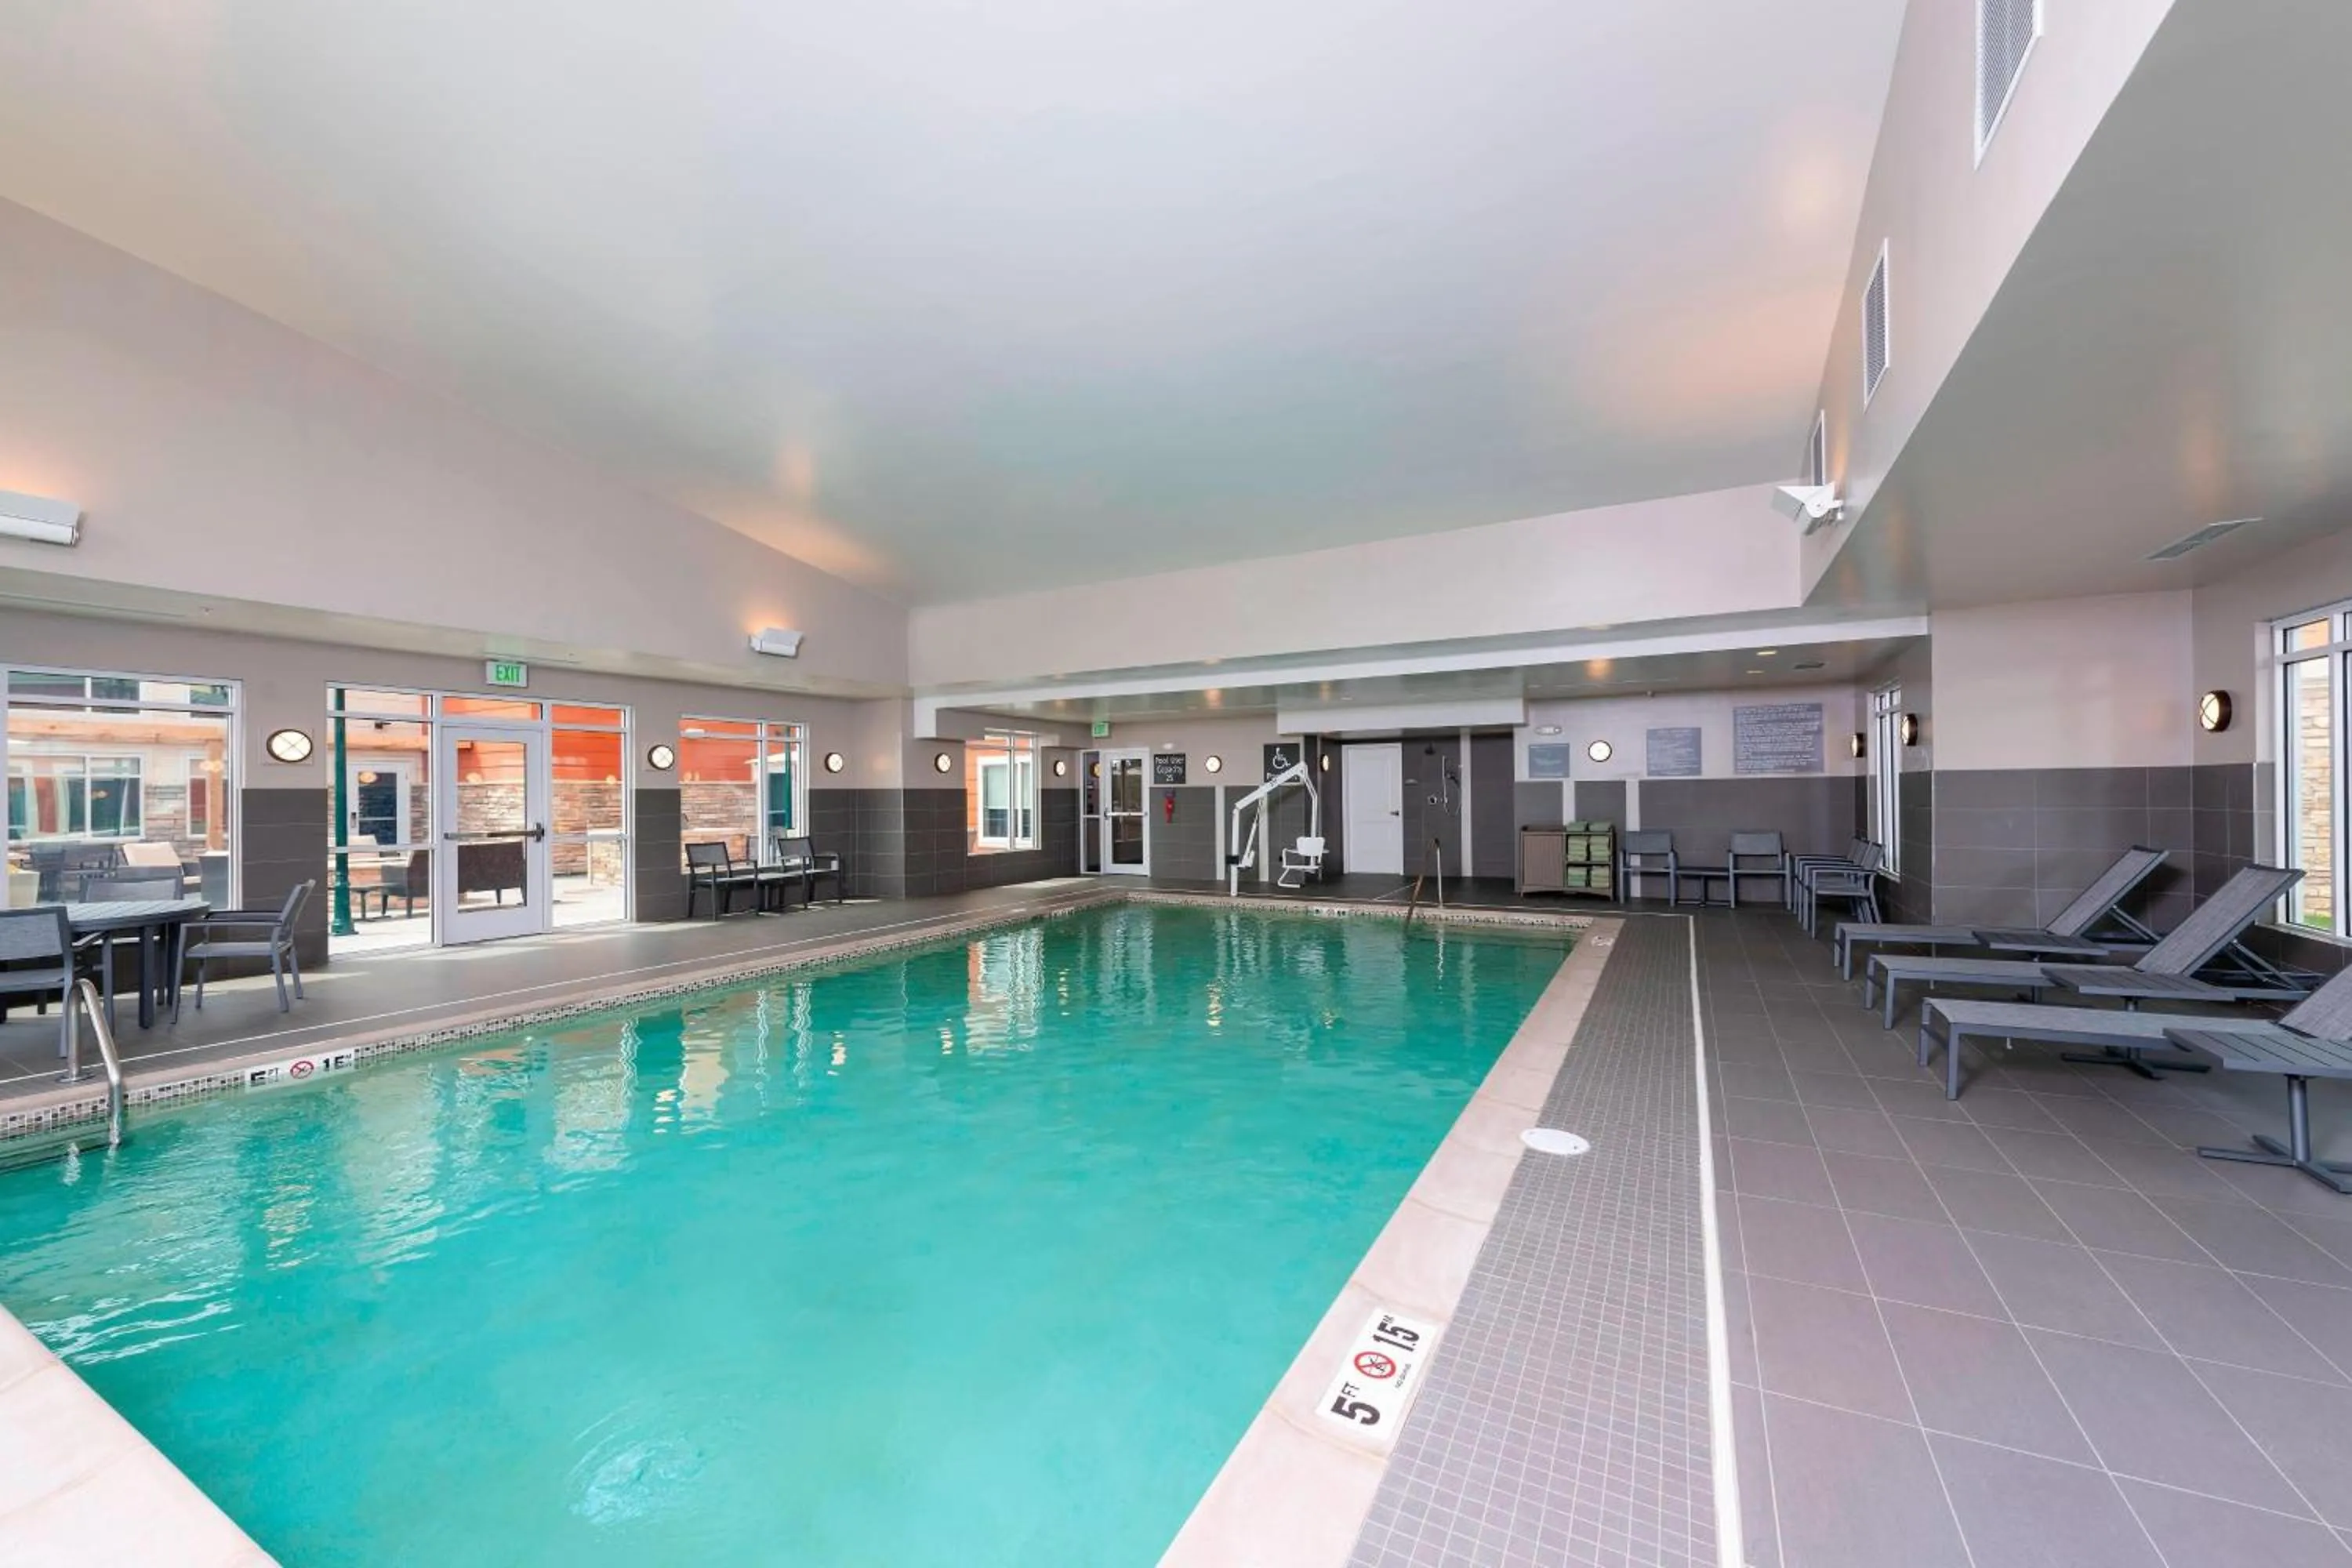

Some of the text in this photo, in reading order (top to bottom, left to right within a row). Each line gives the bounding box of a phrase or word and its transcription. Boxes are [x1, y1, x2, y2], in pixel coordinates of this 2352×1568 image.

[495, 664, 521, 683] EXIT
[1155, 756, 1169, 764] Pool
[1373, 1322, 1420, 1352] 1.5
[1341, 1381, 1359, 1398] FT
[1330, 1395, 1381, 1425] 5
